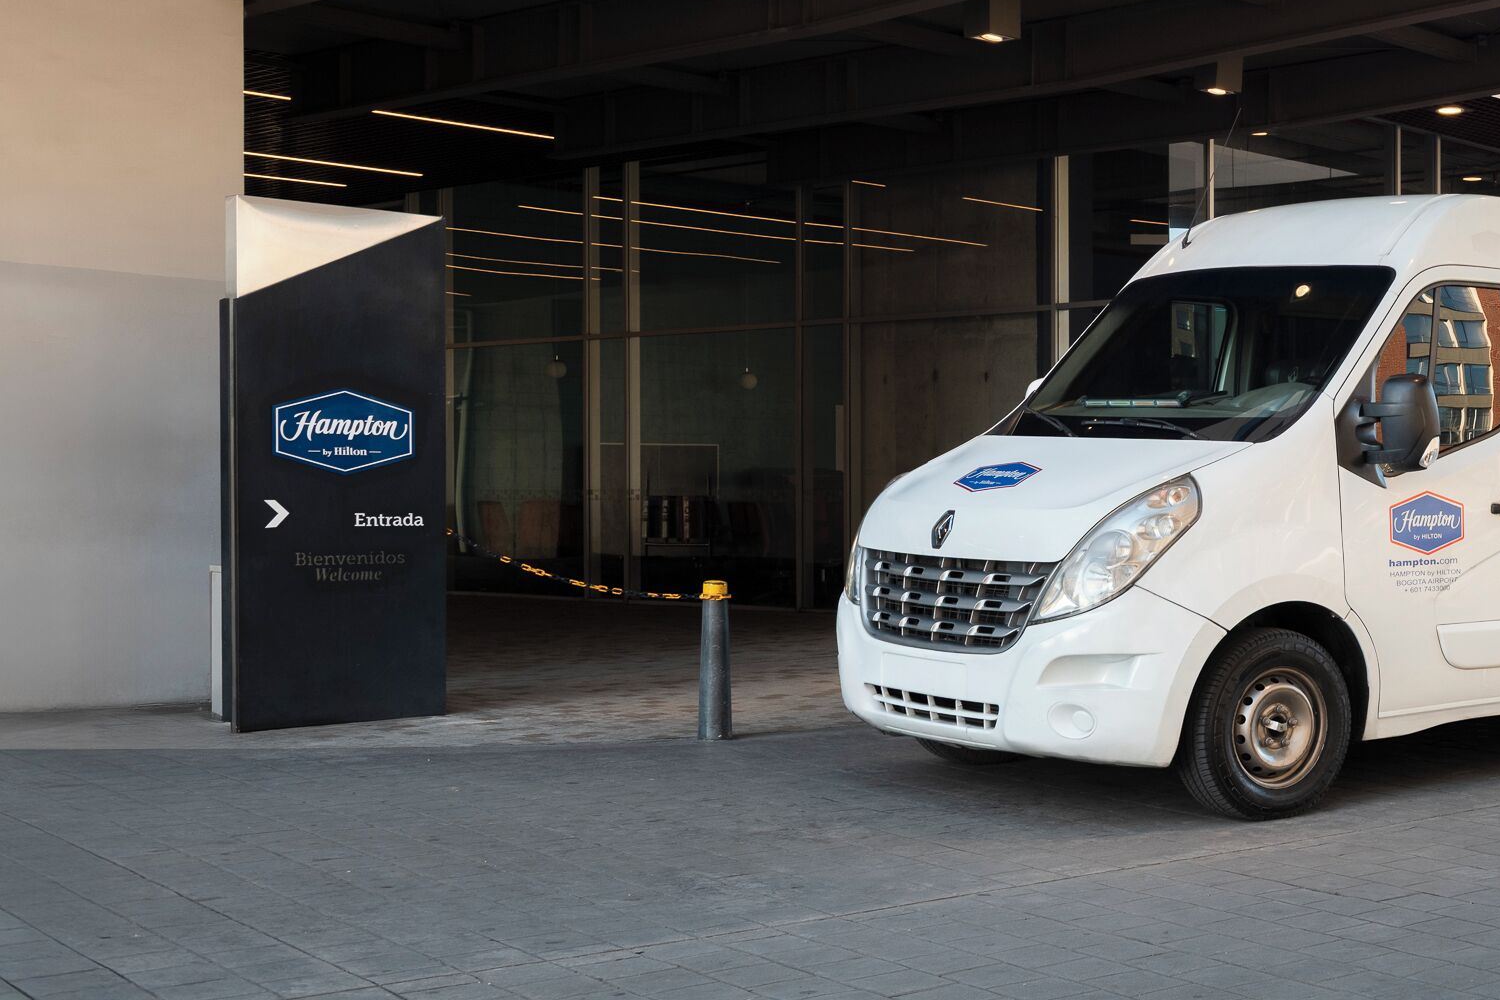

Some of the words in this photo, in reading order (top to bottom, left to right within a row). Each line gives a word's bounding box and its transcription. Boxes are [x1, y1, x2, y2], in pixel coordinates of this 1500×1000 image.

[280, 410, 408, 442] Hampton
[322, 448, 332, 457] by
[334, 446, 367, 456] Hilton
[354, 512, 424, 527] Entrada
[1394, 509, 1460, 533] Hampton
[295, 551, 406, 566] Bienvenidos
[1389, 557, 1458, 568] hampton.com
[315, 567, 382, 582] Welcome
[1389, 570, 1426, 578] HAMPTON
[1427, 569, 1435, 577] by
